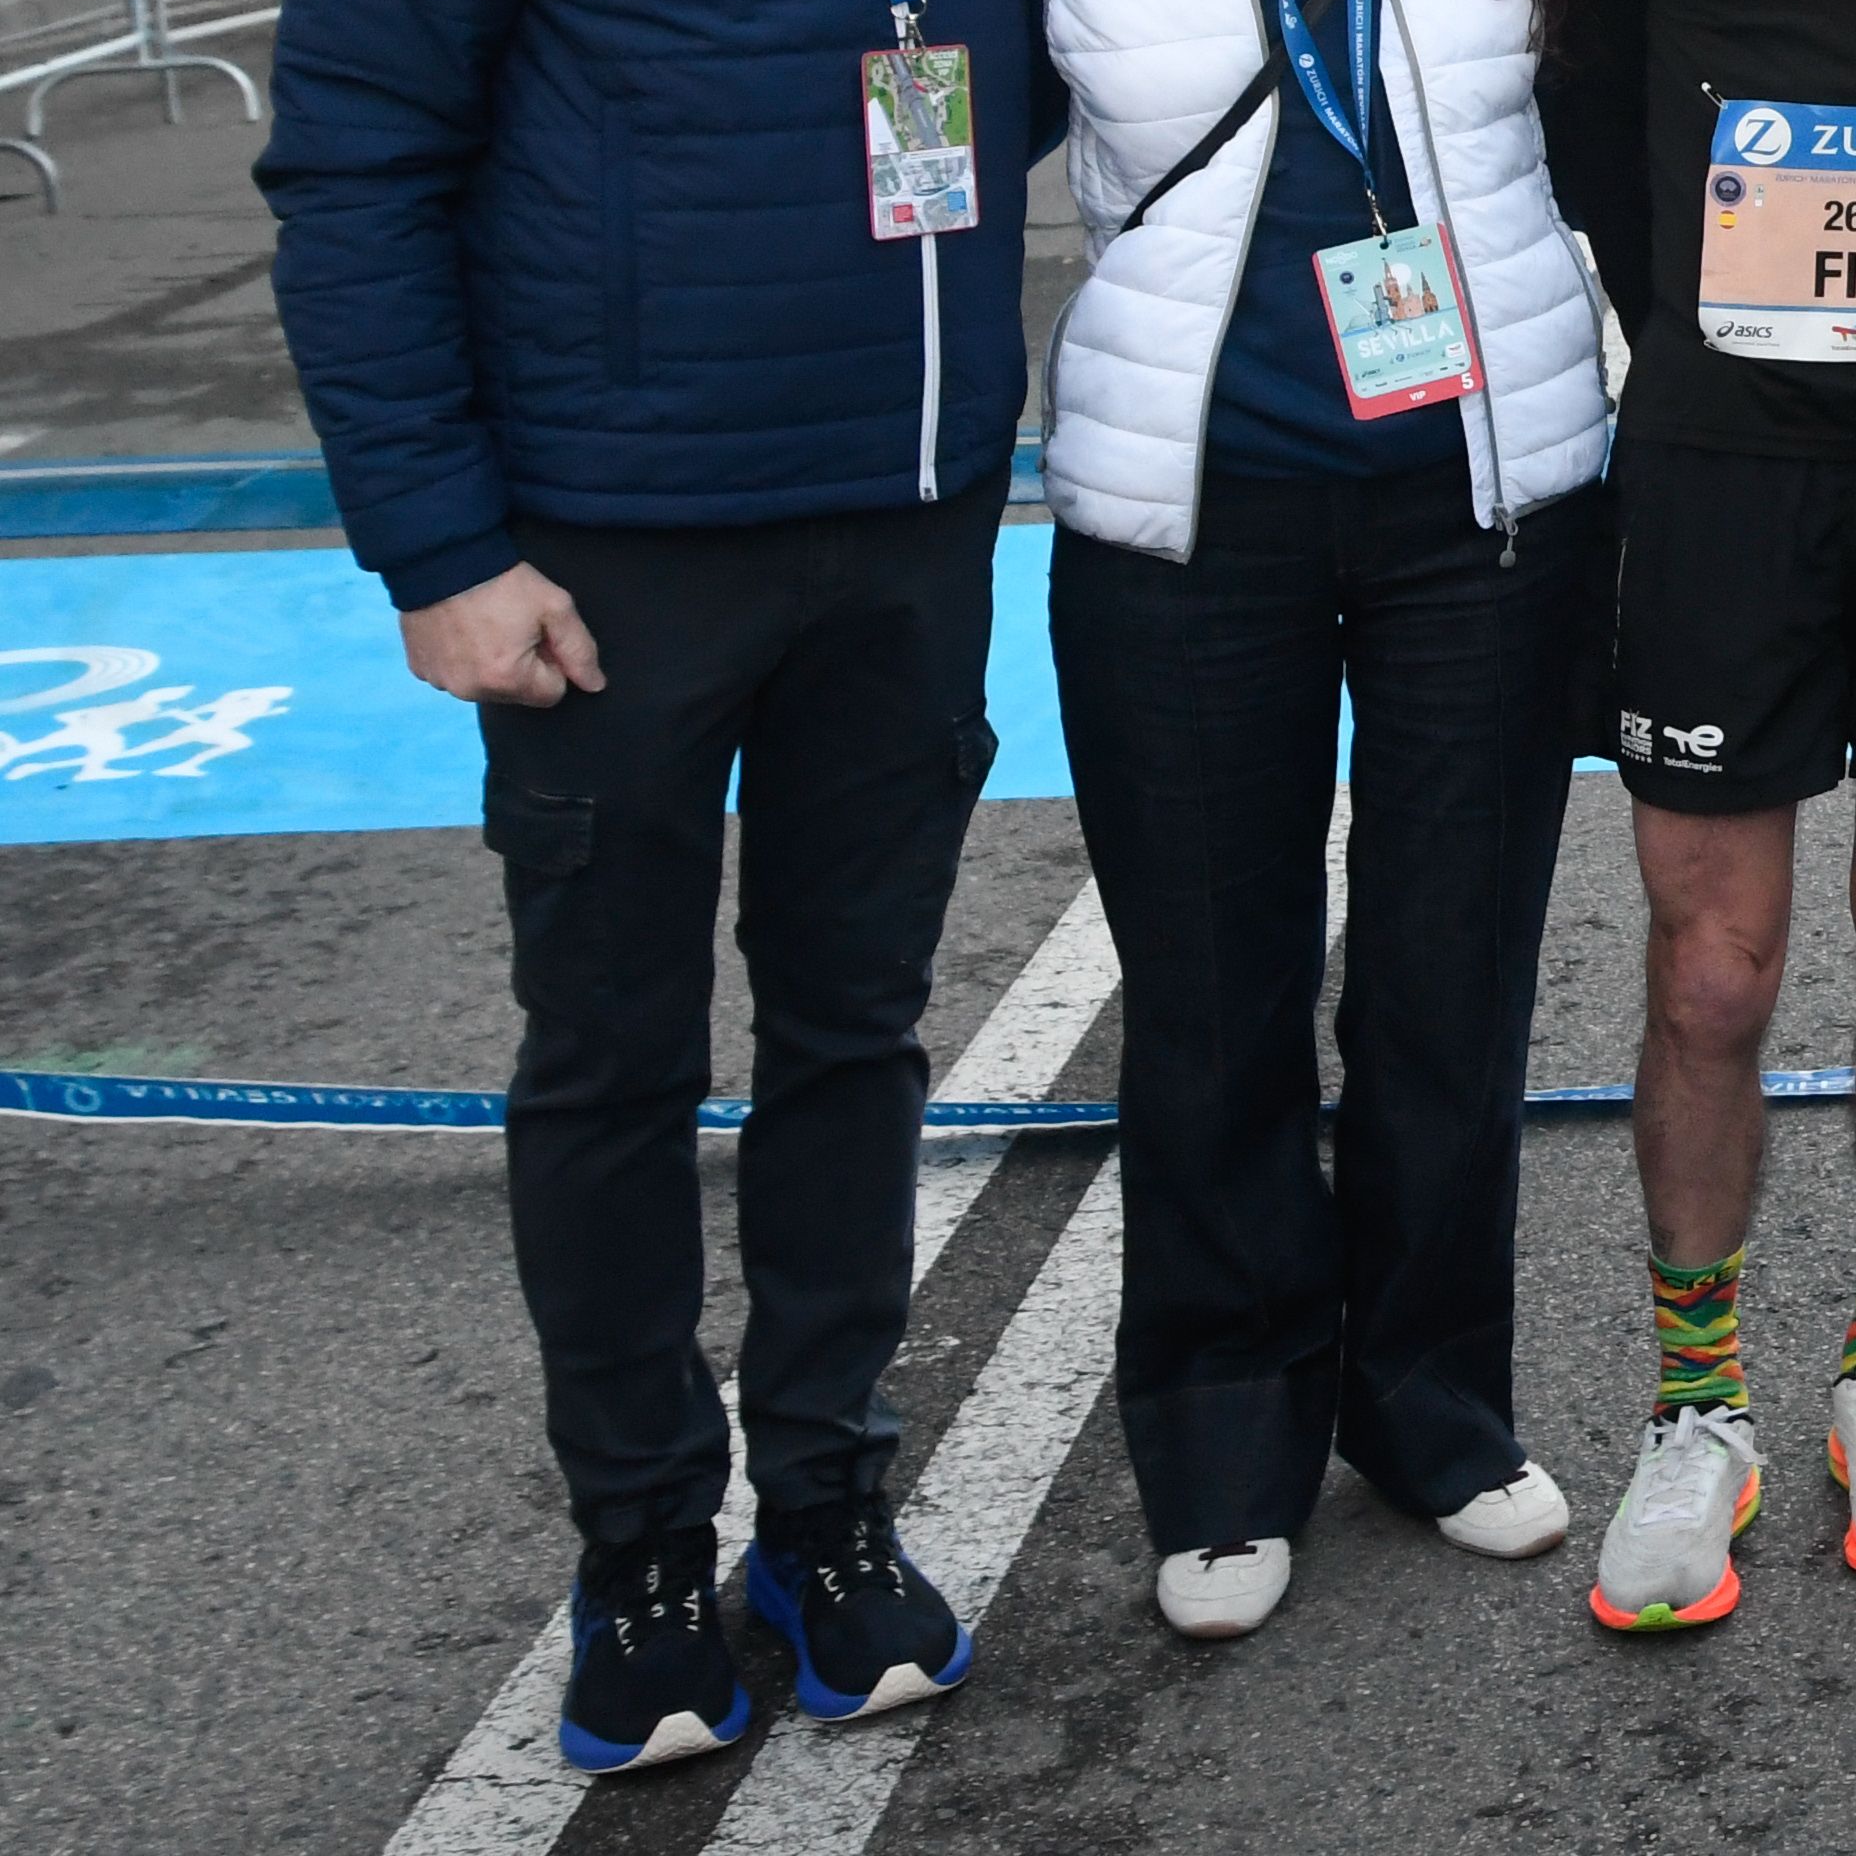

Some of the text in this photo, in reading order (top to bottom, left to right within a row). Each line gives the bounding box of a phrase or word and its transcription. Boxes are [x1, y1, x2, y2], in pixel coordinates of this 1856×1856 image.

[1356, 320, 1456, 359] SEVILLA
[1734, 324, 1774, 340] asics
[1460, 373, 1475, 390] 5
[1409, 390, 1426, 402] VIP
[1663, 756, 1723, 774] TotalEnergies
